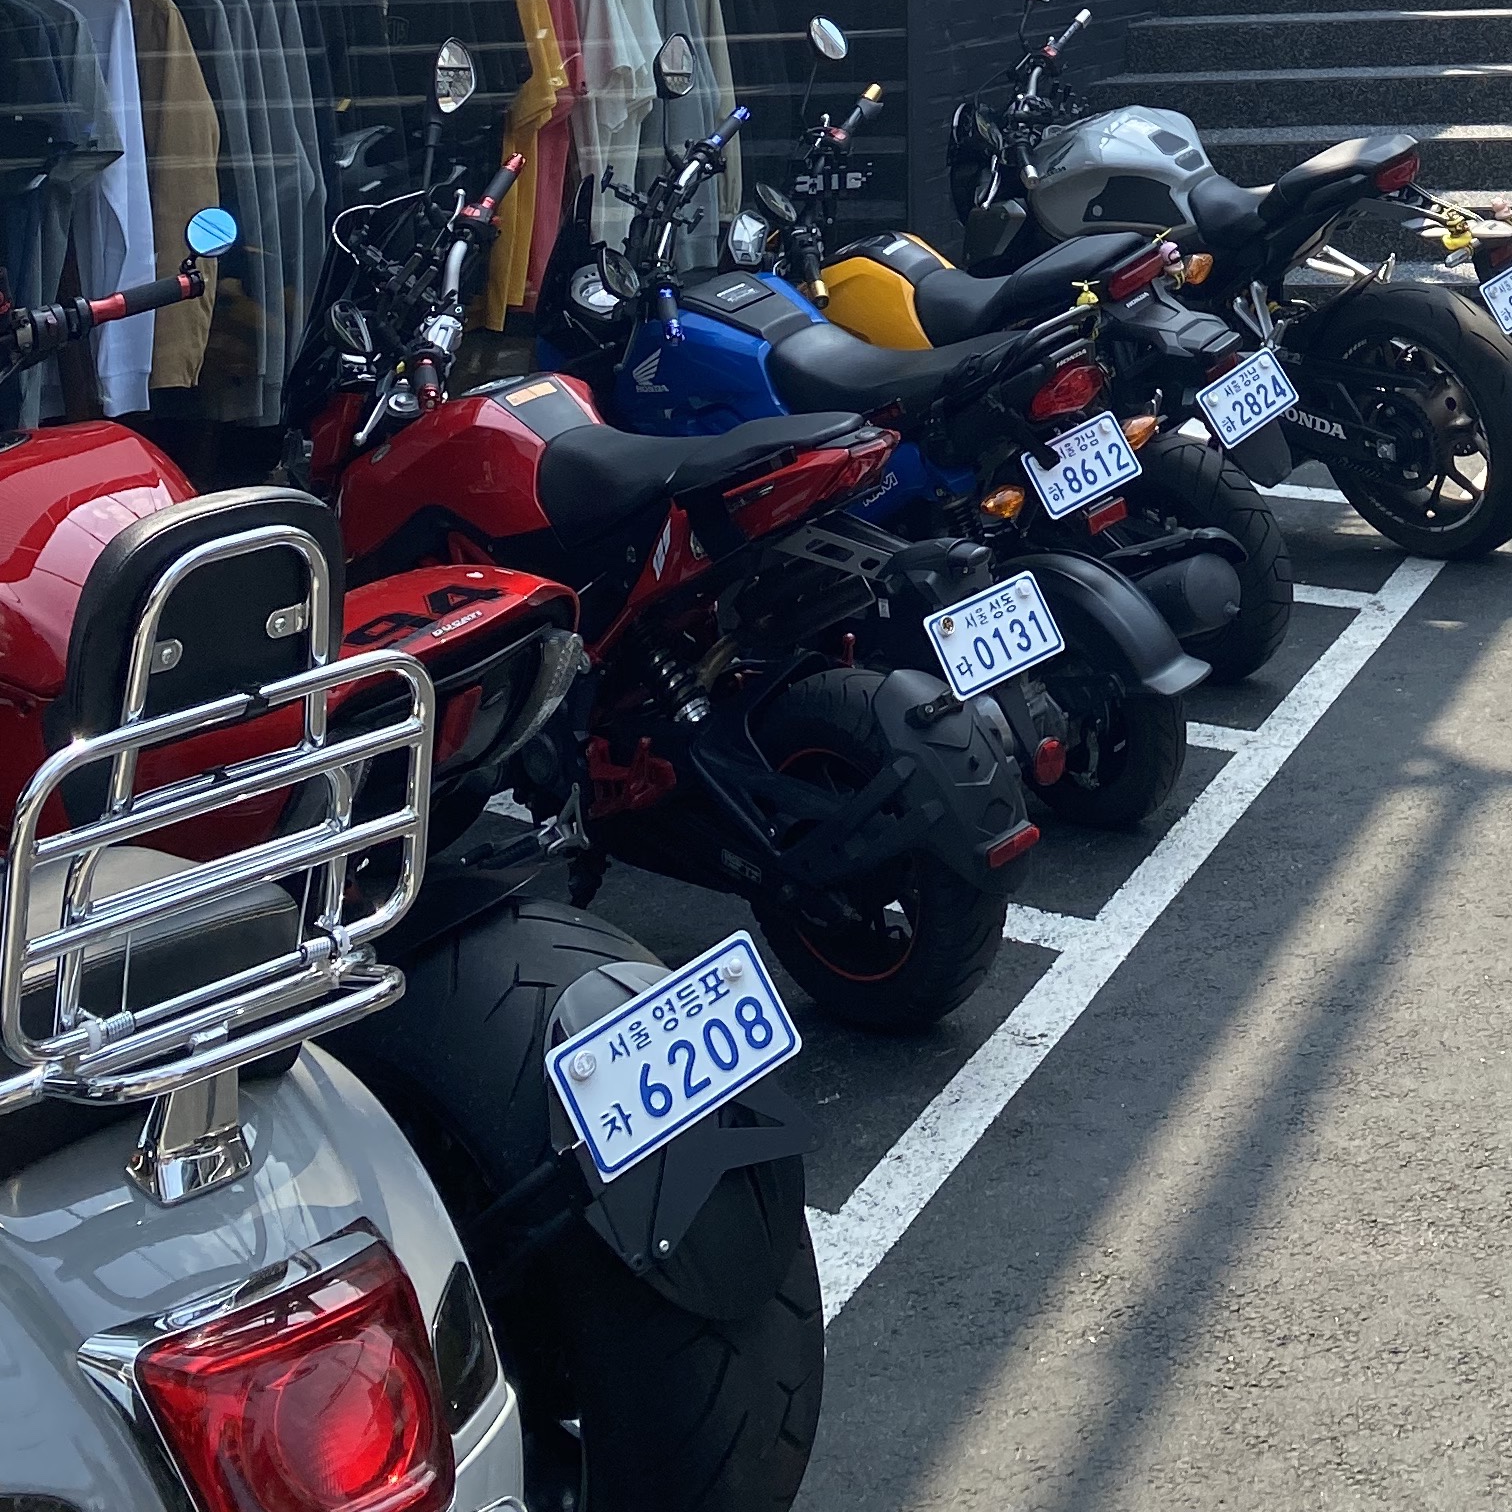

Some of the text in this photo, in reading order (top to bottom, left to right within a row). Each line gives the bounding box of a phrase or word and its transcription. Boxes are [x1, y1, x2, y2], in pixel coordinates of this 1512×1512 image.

[1501, 307, 1512, 322] 하
[1221, 374, 1287, 433] 하 2824
[1279, 407, 1348, 440] ONDA
[1047, 442, 1130, 502] 하 8612
[431, 610, 483, 638] DUCATI
[955, 610, 1048, 678] 다 0131
[607, 967, 731, 1063] 서울 영등포
[600, 996, 774, 1143] 차 6208
